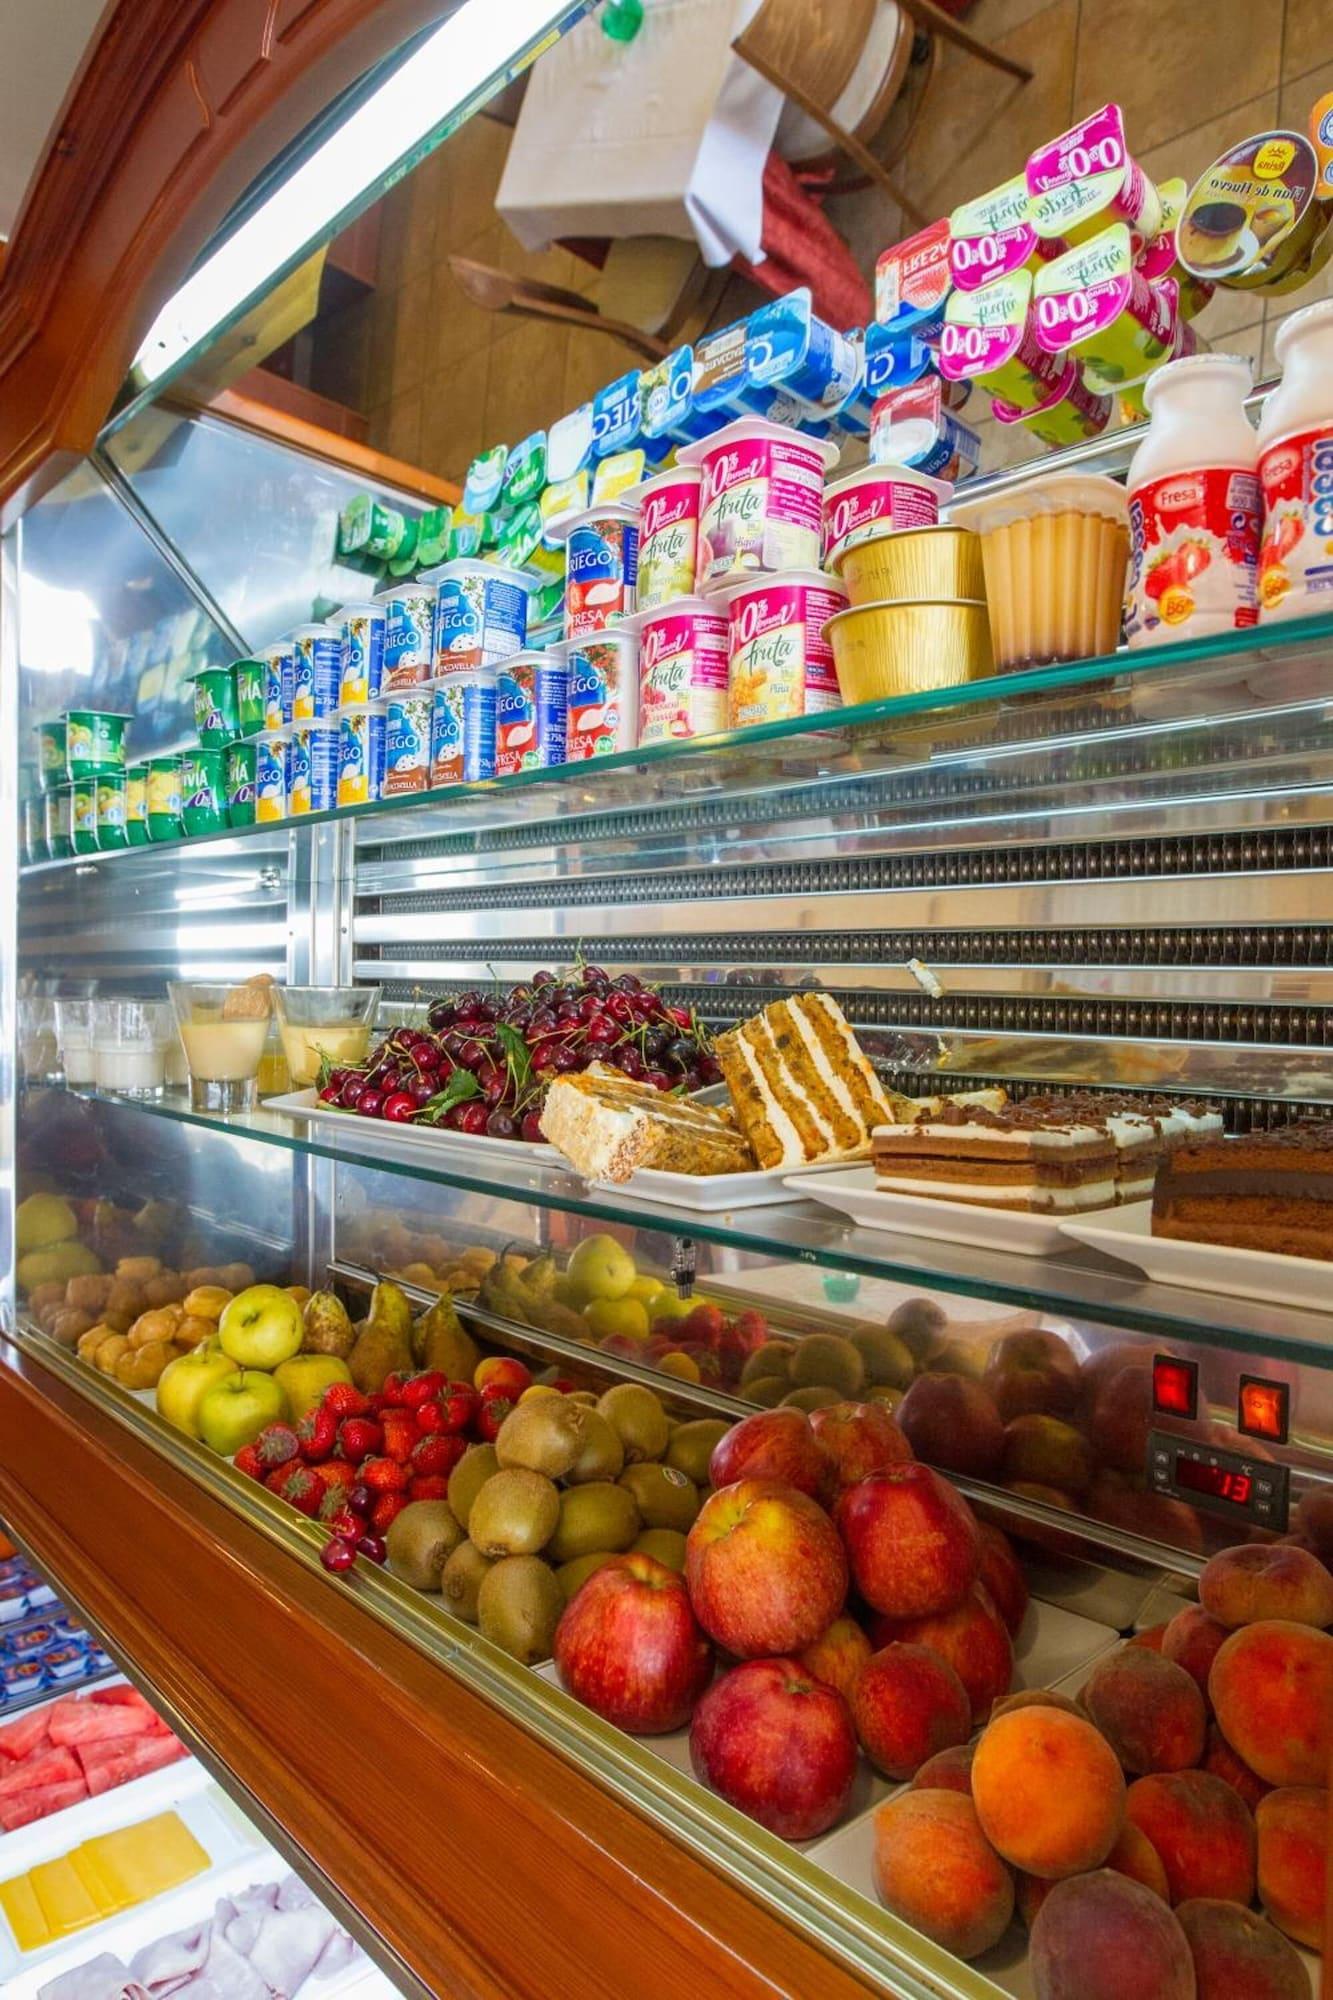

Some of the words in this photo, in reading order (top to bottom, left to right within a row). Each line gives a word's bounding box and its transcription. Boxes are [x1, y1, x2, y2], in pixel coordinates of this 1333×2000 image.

[713, 488, 760, 530] fruta
[1161, 488, 1196, 505] Fresa
[647, 528, 687, 560] fruta
[744, 634, 793, 676] fruta
[649, 661, 687, 692] fruta
[1221, 1473, 1252, 1505] 13
